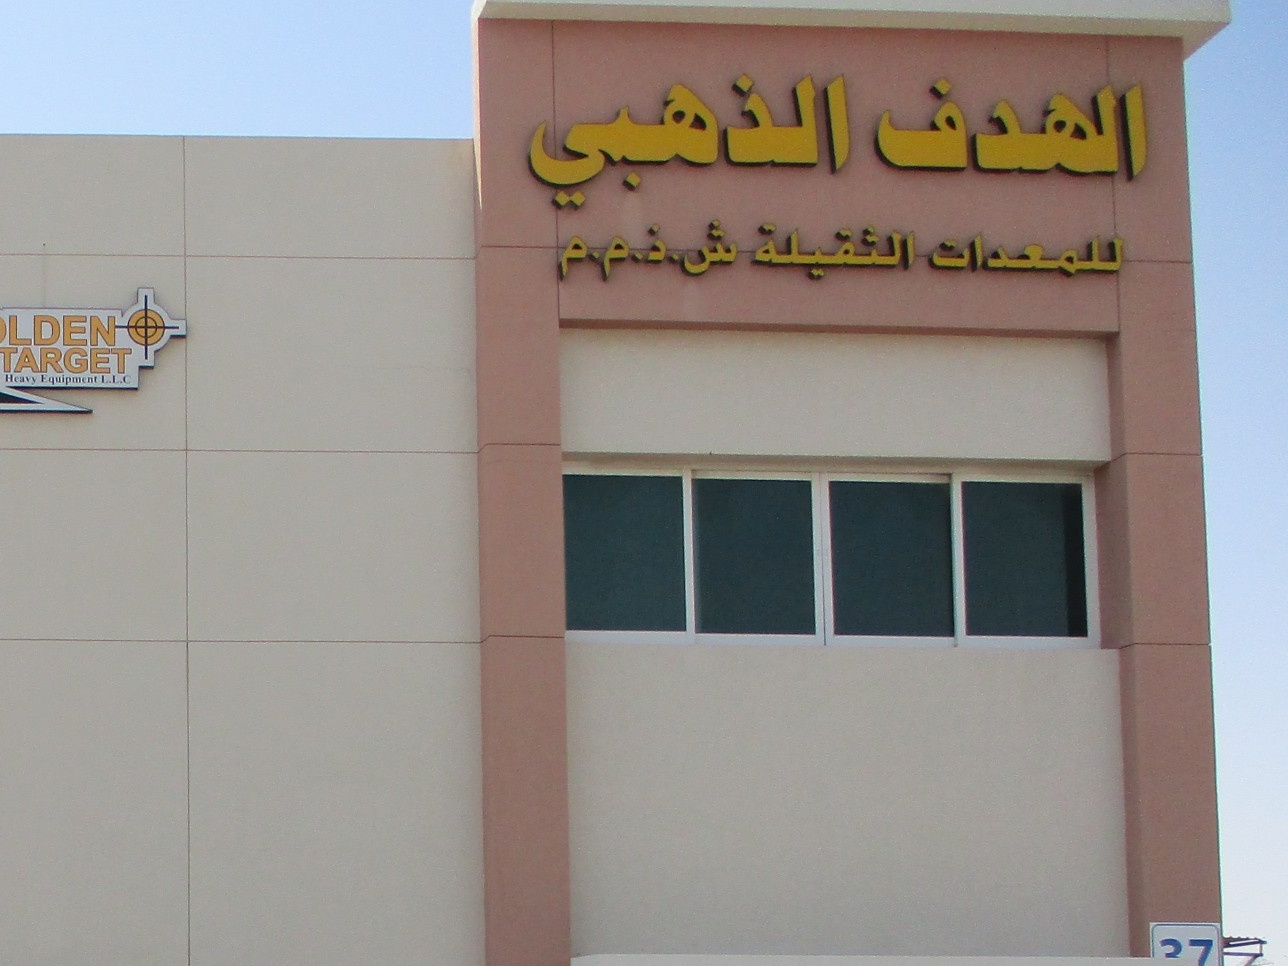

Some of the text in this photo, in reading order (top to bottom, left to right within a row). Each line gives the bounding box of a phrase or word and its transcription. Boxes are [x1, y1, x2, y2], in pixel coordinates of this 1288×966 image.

[528, 74, 1148, 208] الهدف الذهبي
[752, 223, 916, 282] الثقيلة
[928, 235, 1125, 276] للمعدات
[4, 373, 37, 385] Heavy
[40, 373, 98, 385] Equipment
